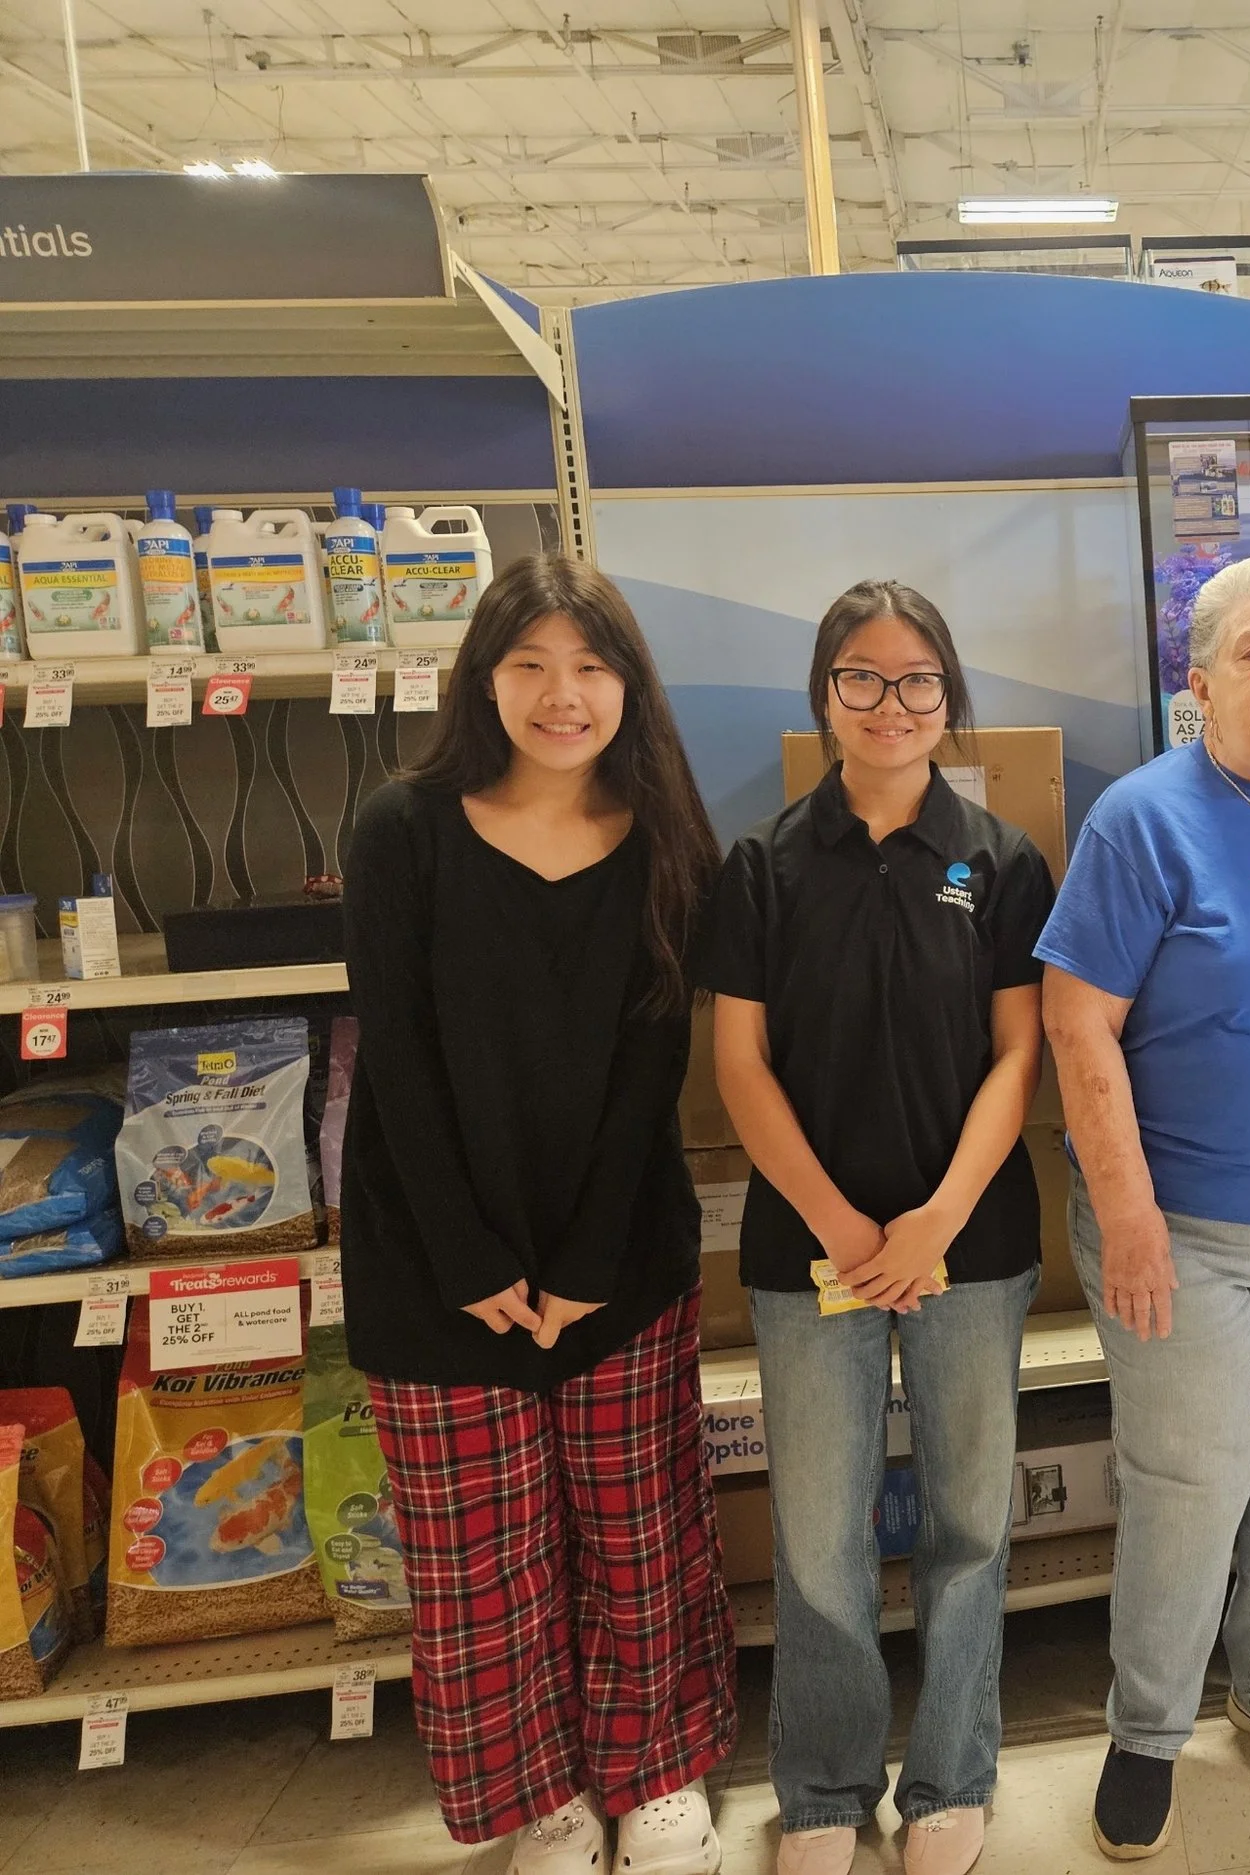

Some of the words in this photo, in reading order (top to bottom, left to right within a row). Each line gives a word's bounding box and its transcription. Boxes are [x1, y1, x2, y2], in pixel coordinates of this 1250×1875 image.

[330, 554, 364, 565] ACCU-
[330, 565, 364, 576] CLEAR
[405, 566, 461, 576] ACCU-CLEAR
[33, 576, 61, 585] AQUA
[61, 574, 107, 584] ESSENTIAL
[1174, 710, 1206, 722] SOL
[1176, 723, 1195, 735] AS
[942, 885, 973, 901] Ustart
[935, 893, 976, 913] Teaching
[24, 1012, 65, 1021] Clearance
[200, 1059, 224, 1071] Tetra
[200, 1074, 230, 1085] Pond
[166, 1091, 201, 1106] Spring
[203, 1090, 212, 1101] &
[214, 1086, 238, 1100] Fall
[240, 1085, 266, 1098] Diet
[170, 1278, 218, 1292] Treats
[222, 1270, 278, 1287] rewards
[171, 1303, 196, 1314] BUY
[250, 1309, 271, 1319] pond
[272, 1307, 291, 1315] food
[176, 1313, 200, 1324] GET
[245, 1317, 287, 1326] watercare
[168, 1324, 191, 1335] THE
[162, 1335, 189, 1346] 25%
[191, 1332, 215, 1343] OFF
[152, 1374, 198, 1393] Koi
[203, 1367, 305, 1393] Vibrance
[704, 1435, 764, 1465] ptio
